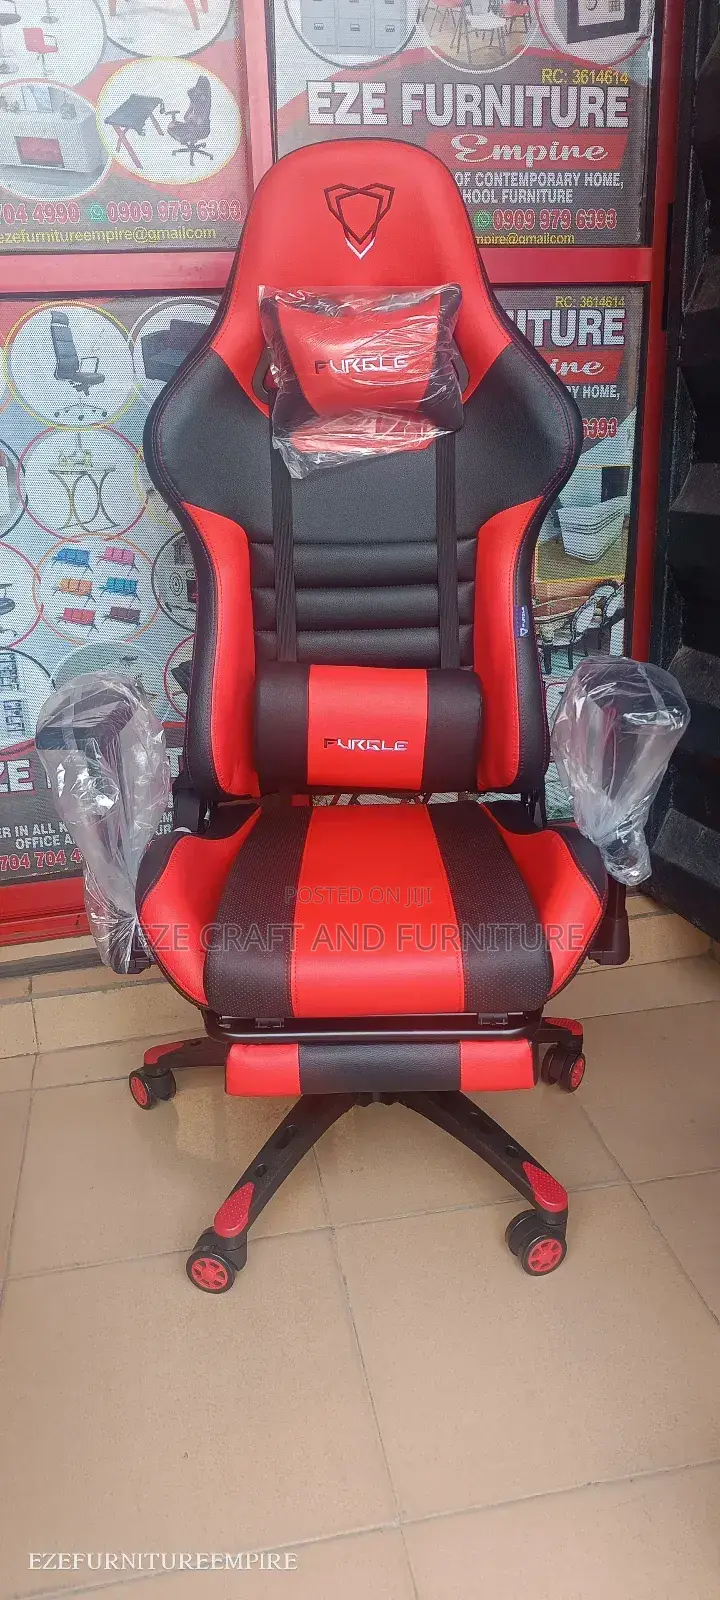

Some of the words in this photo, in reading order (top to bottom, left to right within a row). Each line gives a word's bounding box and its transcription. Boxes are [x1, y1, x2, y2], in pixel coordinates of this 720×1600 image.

[541, 68, 567, 83] RC:
[572, 67, 629, 85] 3614614
[307, 81, 388, 125] EZE
[401, 83, 631, 128] FURNITURE
[450, 133, 609, 168] Empire
[455, 171, 472, 187] OF
[475, 171, 581, 187] CONTEMPORARY
[584, 172, 625, 190] HOME,
[460, 188, 499, 204] HOOL
[501, 188, 574, 204] FURNITURE
[0, 202, 28, 225] 04
[32, 202, 81, 224] 4990
[106, 201, 153, 223] 0909
[157, 200, 193, 222] 979
[197, 199, 243, 222] 6393
[492, 208, 536, 231] 0909
[539, 208, 572, 231] 979
[575, 208, 618, 231] 6393
[555, 296, 576, 308] RC:
[506, 309, 625, 347] ITURE
[583, 385, 620, 400] HOME,
[323, 738, 409, 751] FURGLE
[14, 825, 29, 837] IN
[32, 822, 56, 835] ALL
[15, 834, 61, 850] OFFICE
[34, 850, 67, 868] 704
